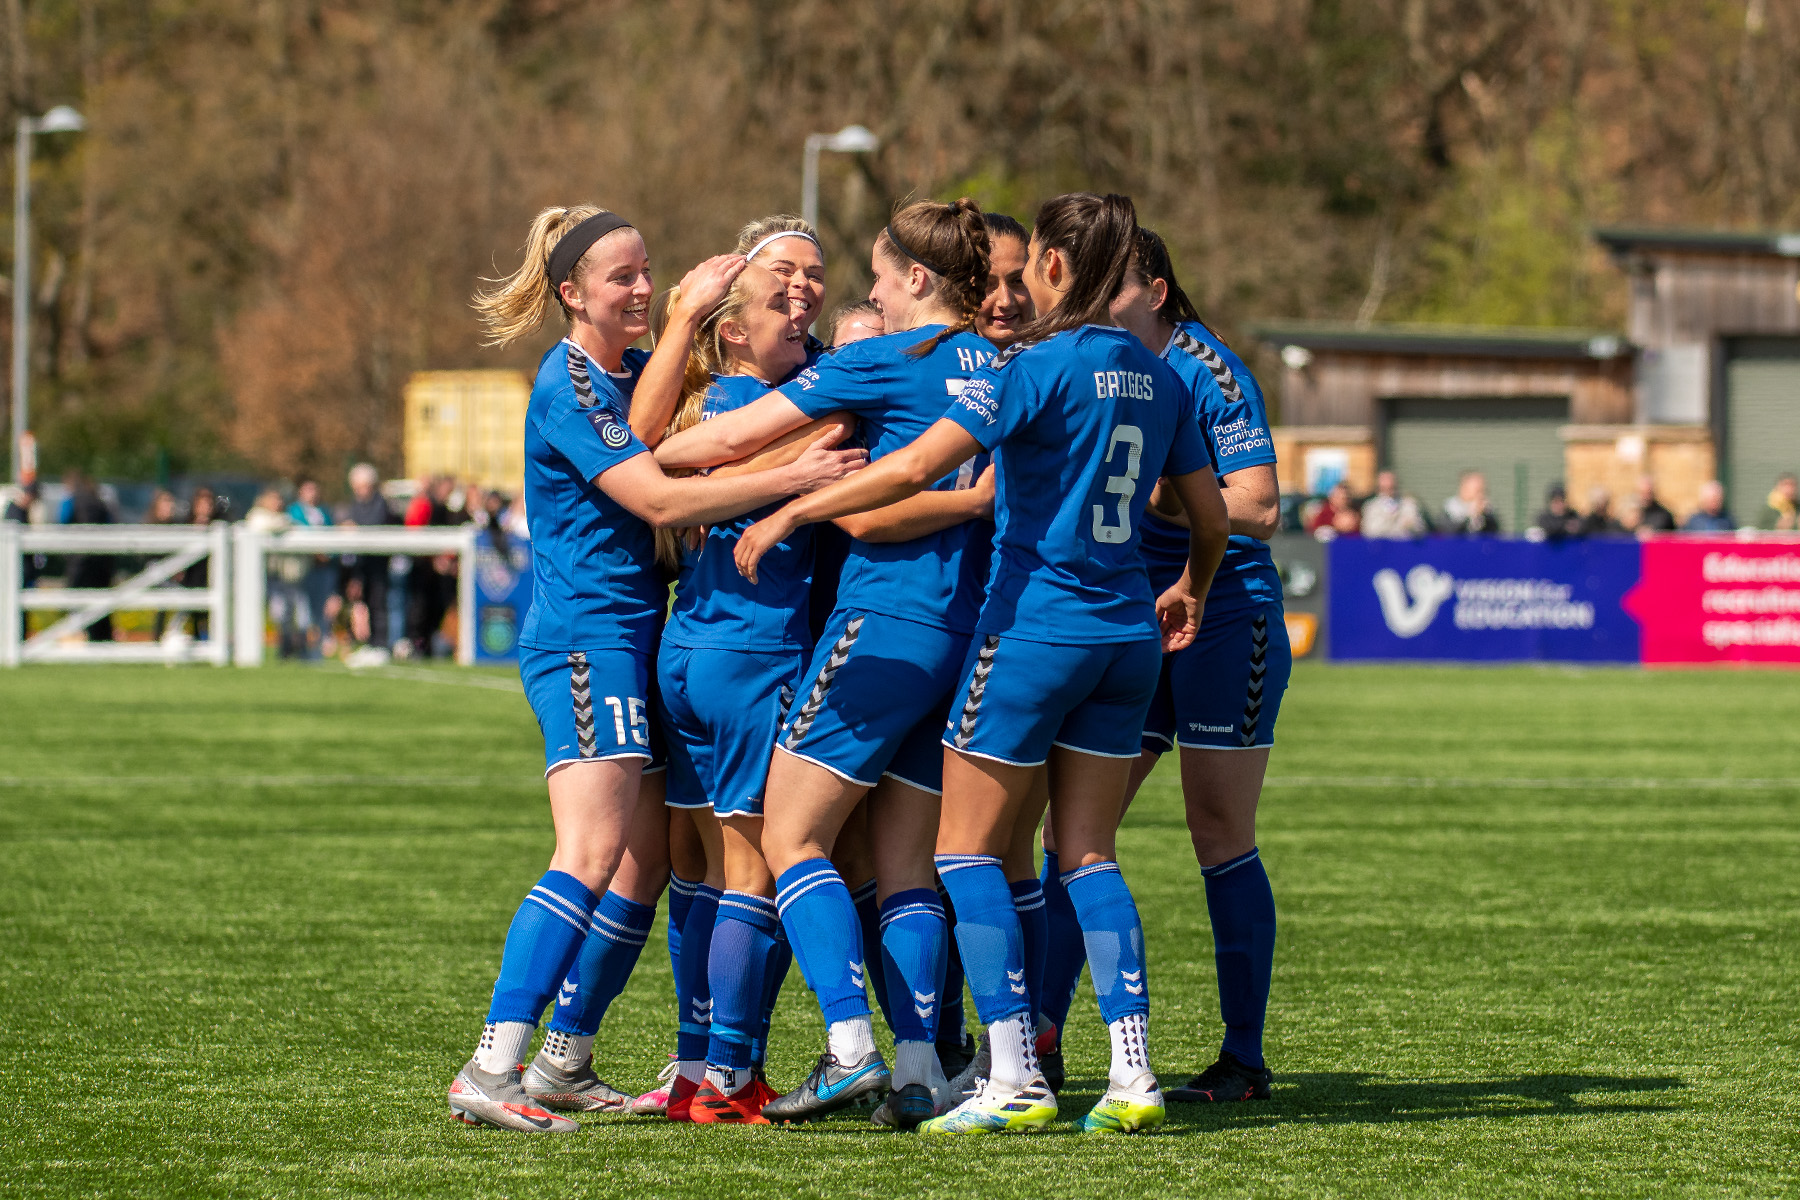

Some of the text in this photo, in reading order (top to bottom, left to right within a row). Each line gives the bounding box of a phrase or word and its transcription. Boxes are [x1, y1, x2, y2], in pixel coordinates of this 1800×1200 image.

[1094, 370, 1154, 401] BRIGGS
[1213, 417, 1250, 437] Plastic
[1216, 427, 1265, 447] Furniture
[1220, 437, 1271, 457] Company
[1092, 423, 1144, 544] 3
[1454, 601, 1595, 630] EDUCATION
[604, 696, 649, 747] 15
[1198, 722, 1234, 733] hummel
